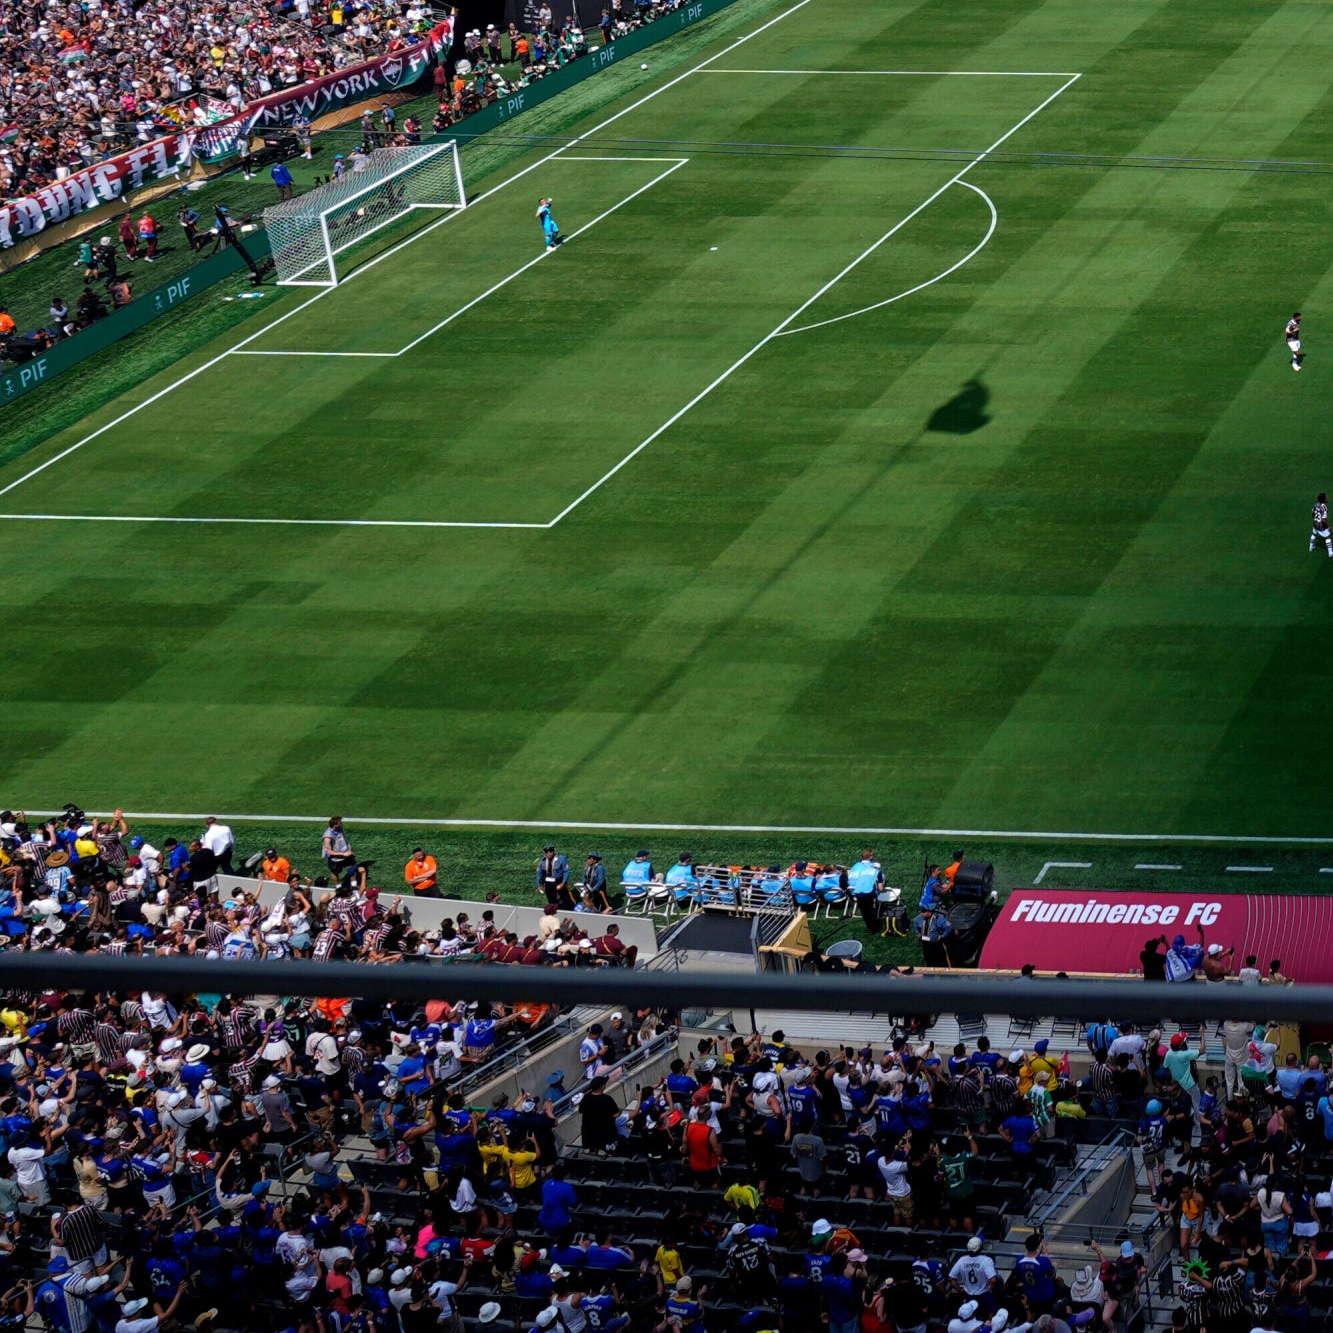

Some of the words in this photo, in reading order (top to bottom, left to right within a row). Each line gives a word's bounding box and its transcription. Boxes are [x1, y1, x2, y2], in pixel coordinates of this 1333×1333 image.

[688, 2, 703, 22] PIF
[600, 45, 615, 66] PIF
[263, 92, 318, 126] NEW
[320, 70, 379, 104] YORK
[507, 93, 525, 114] PIF
[167, 276, 191, 304] PIF
[20, 357, 47, 388] PIF
[1010, 898, 1177, 925] Fluminense
[1184, 901, 1222, 926] FC
